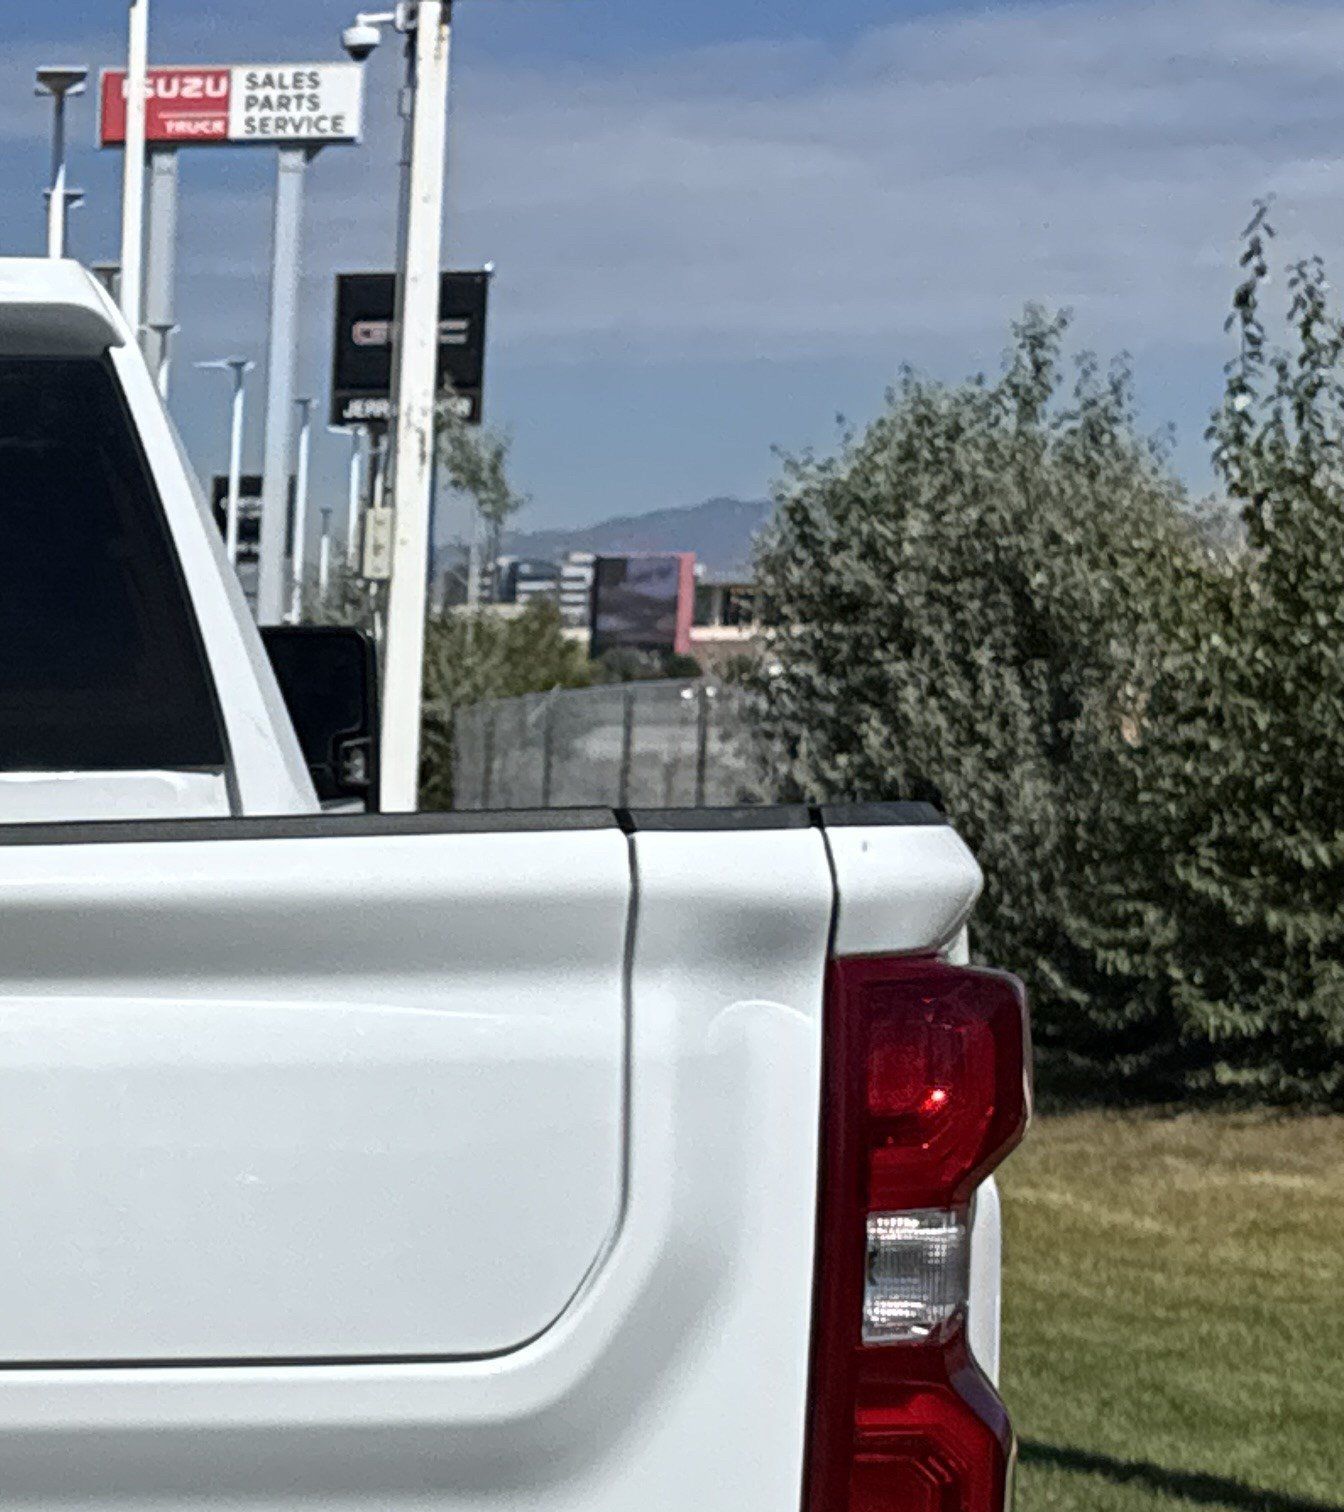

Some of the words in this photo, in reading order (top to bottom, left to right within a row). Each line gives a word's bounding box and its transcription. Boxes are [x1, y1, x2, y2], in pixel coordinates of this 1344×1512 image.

[244, 72, 321, 91] SALES
[244, 94, 321, 113] PARTS
[165, 119, 226, 134] TRUCK
[244, 115, 346, 135] SERVICE
[352, 320, 469, 346] GC
